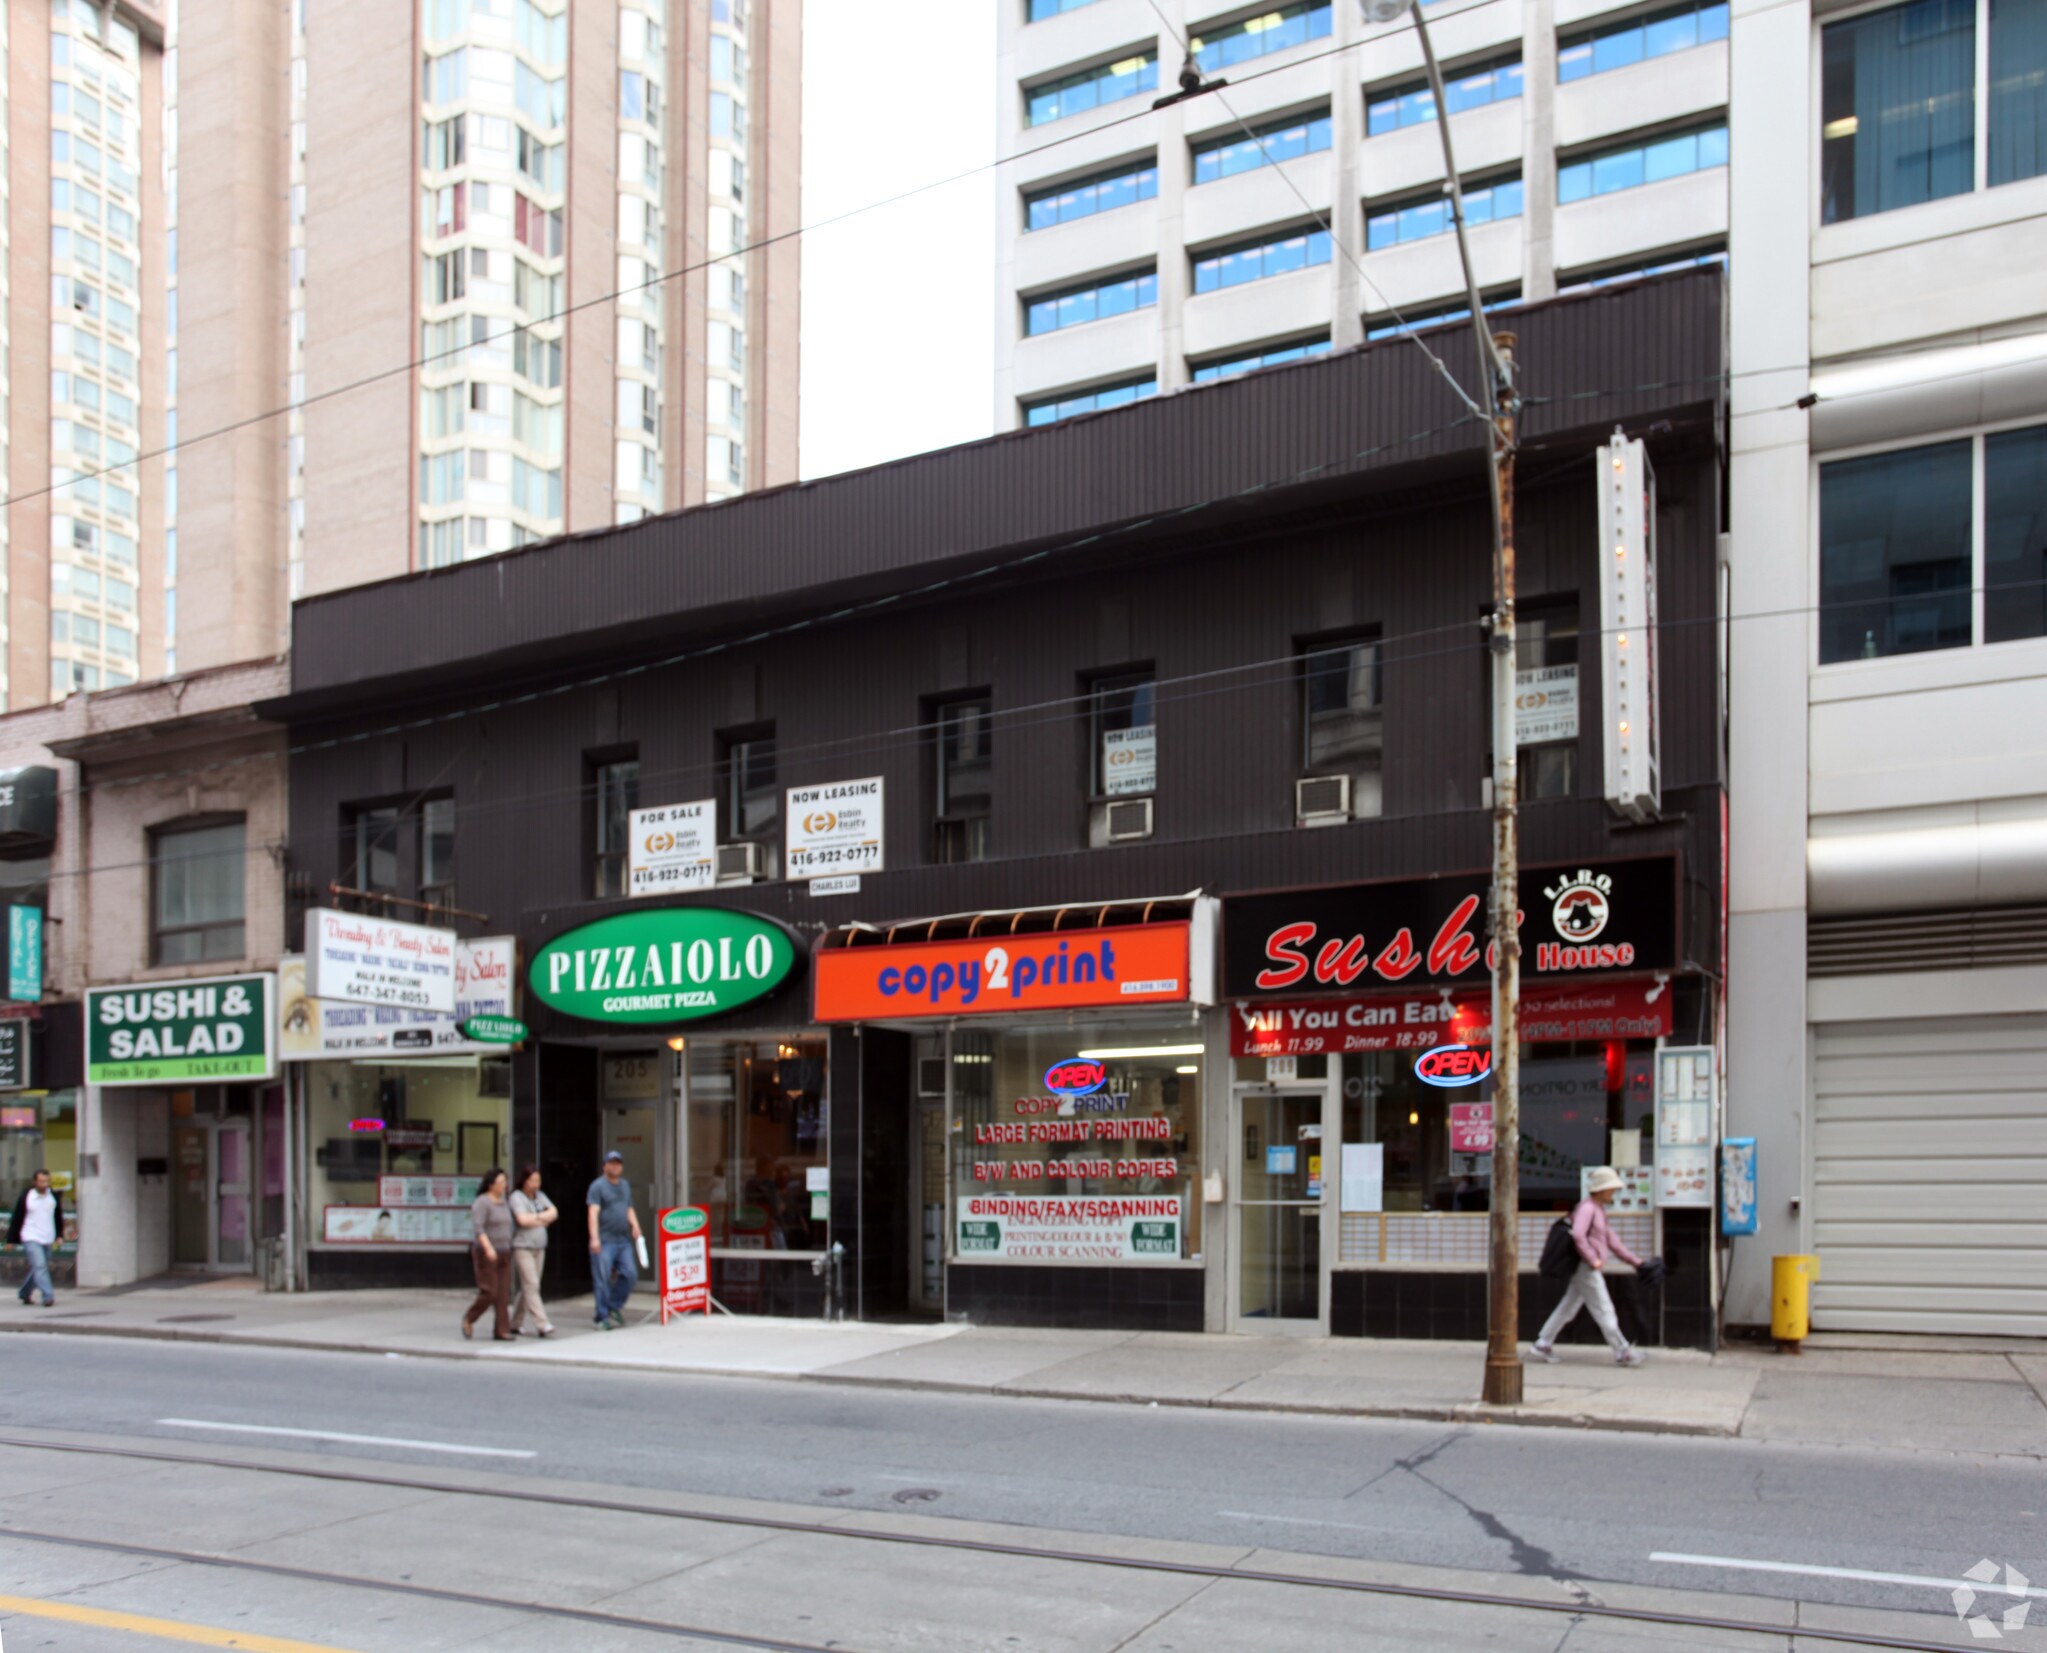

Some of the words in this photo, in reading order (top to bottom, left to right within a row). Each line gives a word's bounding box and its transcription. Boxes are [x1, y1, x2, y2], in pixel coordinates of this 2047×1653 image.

[793, 790, 820, 804] NOW
[825, 782, 878, 800] LEASING
[640, 810, 665, 824] FOR
[671, 806, 702, 820] SALE
[790, 846, 878, 867] 416-922-0777
[633, 864, 712, 884] 416-922-0777
[811, 880, 842, 892] CHARLES
[470, 949, 507, 982] Salon
[549, 933, 773, 994] PIZZAIOLO
[1537, 941, 1635, 972] House
[877, 939, 1116, 1005] copy2print
[100, 987, 217, 1025] SUSHI
[221, 985, 252, 1017] &
[602, 994, 672, 1013] GOURMET
[675, 990, 717, 1008] PIZZA
[1252, 1010, 1282, 1032] All
[1288, 1007, 1339, 1030] You
[1345, 1004, 1397, 1027] Can
[1403, 1001, 1453, 1024] Eat
[1615, 1015, 1662, 1037] Only)
[109, 1022, 245, 1060] SALAD
[1244, 1038, 1282, 1054] Lunch
[1287, 1036, 1324, 1052] 11.99
[1344, 1034, 1389, 1049] Dinner
[1395, 1030, 1439, 1047] 18.99
[187, 1059, 254, 1076] TAKE-OUT
[613, 1060, 648, 1079] 205
[1419, 1050, 1491, 1077] OPEN
[1047, 1064, 1105, 1089] OPEN
[975, 1122, 1026, 1146] LARGE
[1028, 1119, 1092, 1144] FORMAT
[1094, 1116, 1171, 1141] PRINTING
[974, 1161, 1007, 1183] B/W
[1009, 1160, 1044, 1181] AND
[1046, 1158, 1113, 1180] COLOUR
[1115, 1157, 1178, 1178] COPIES
[969, 1199, 1179, 1219] BINDING/FAX/SCANNING
[965, 1223, 988, 1236] WIDE
[1141, 1223, 1167, 1237] WIDE
[961, 1238, 996, 1250] FORMAT
[1006, 1246, 1057, 1258] COLOUR
[1058, 1246, 1123, 1259] SCANNING
[1136, 1239, 1175, 1251] FORMAT
